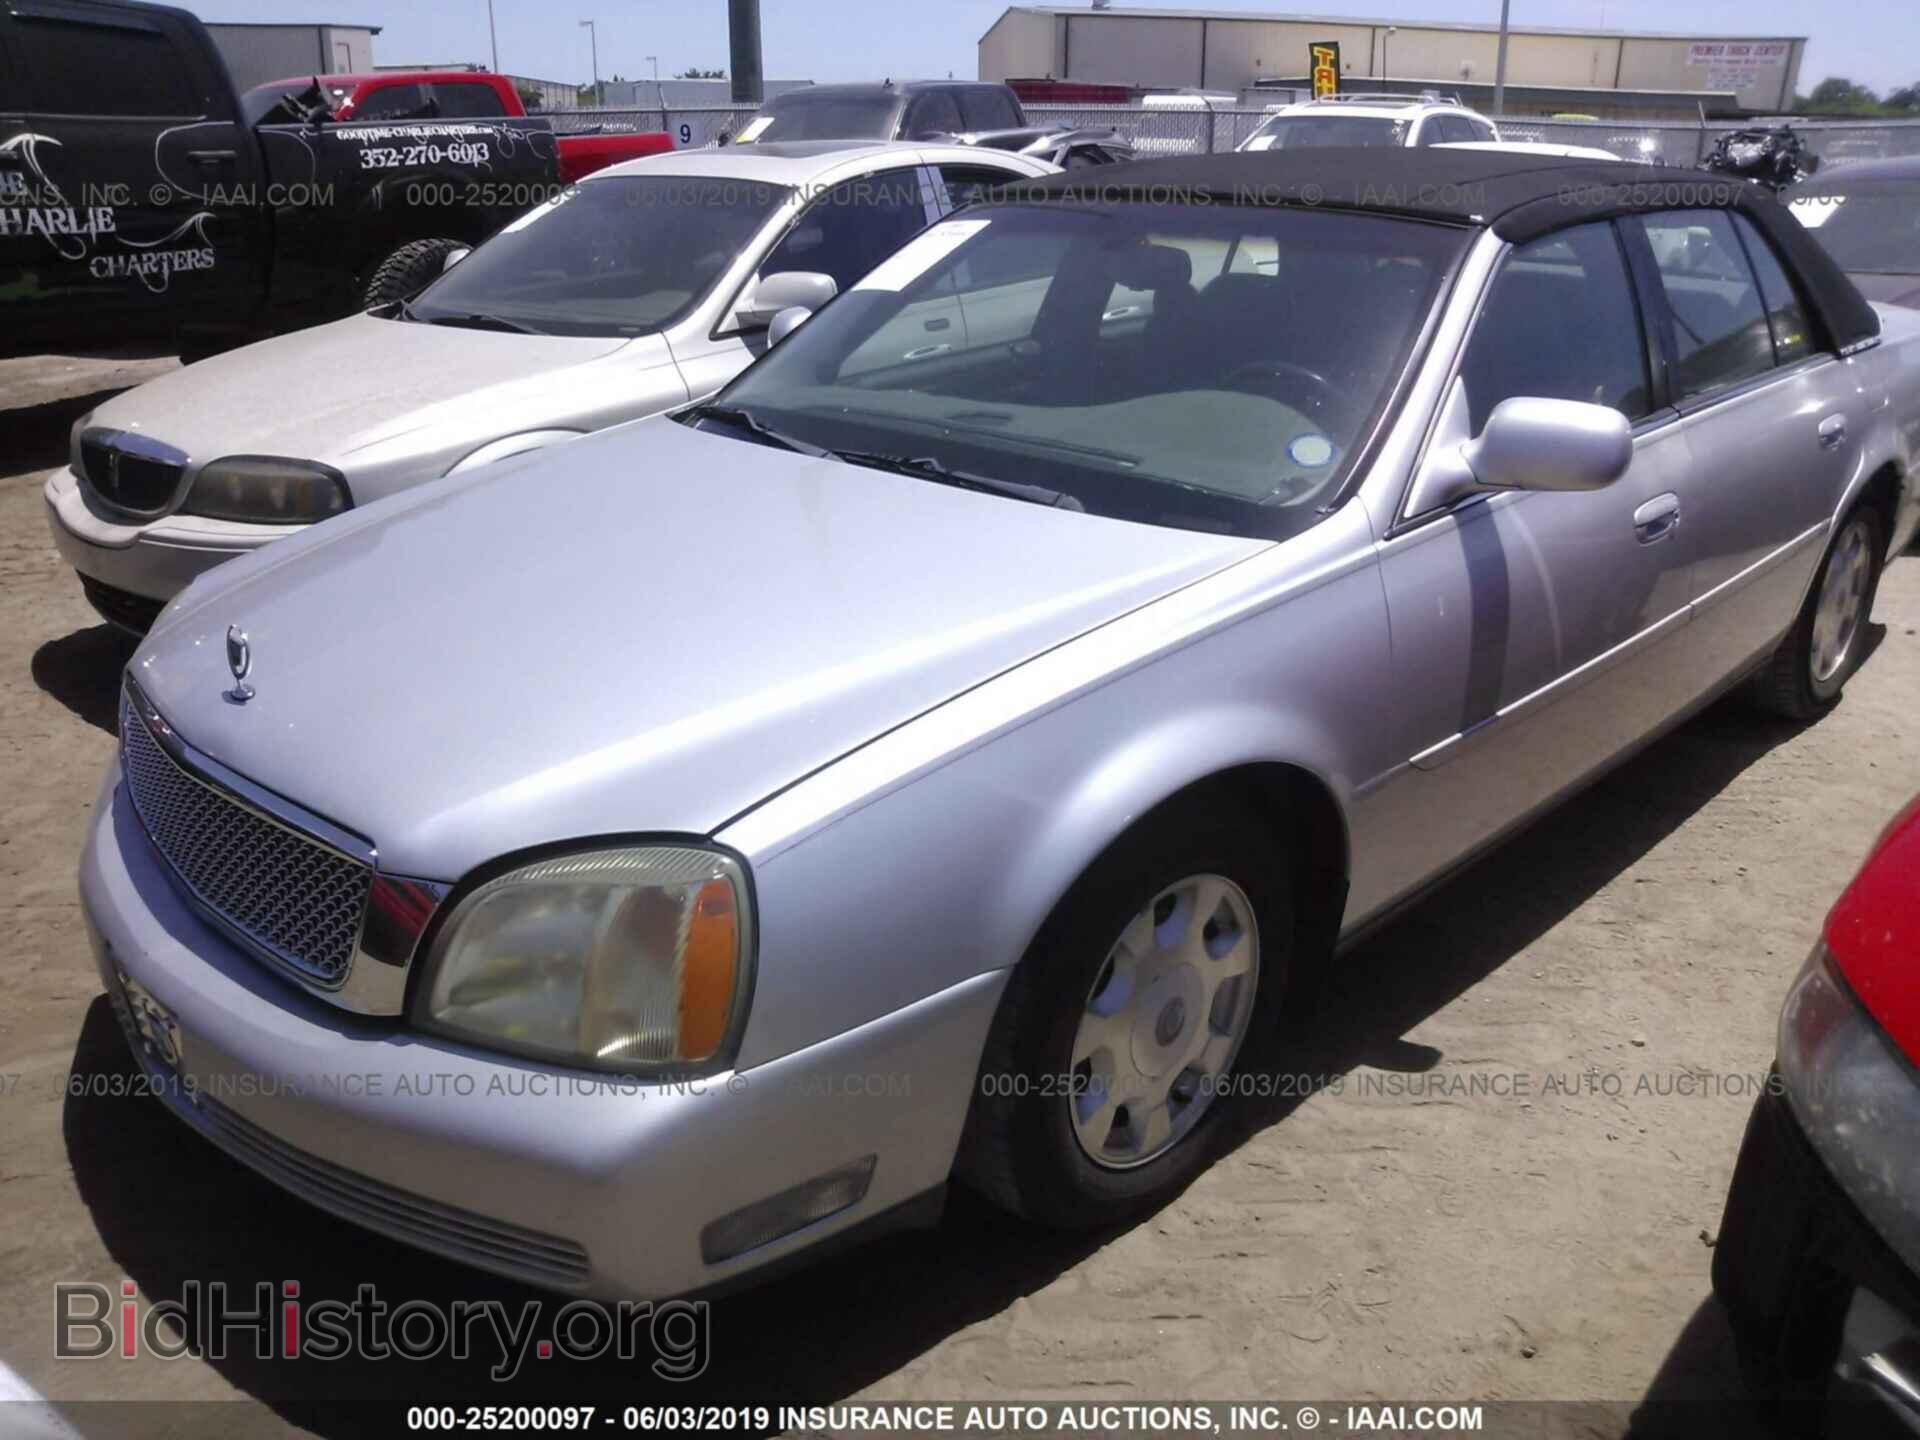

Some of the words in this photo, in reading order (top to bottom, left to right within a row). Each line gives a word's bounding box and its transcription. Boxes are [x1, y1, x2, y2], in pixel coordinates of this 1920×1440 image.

[680, 124, 691, 144] 9
[360, 143, 490, 168] 352-270-6013
[89, 248, 215, 279] CHARTERS
